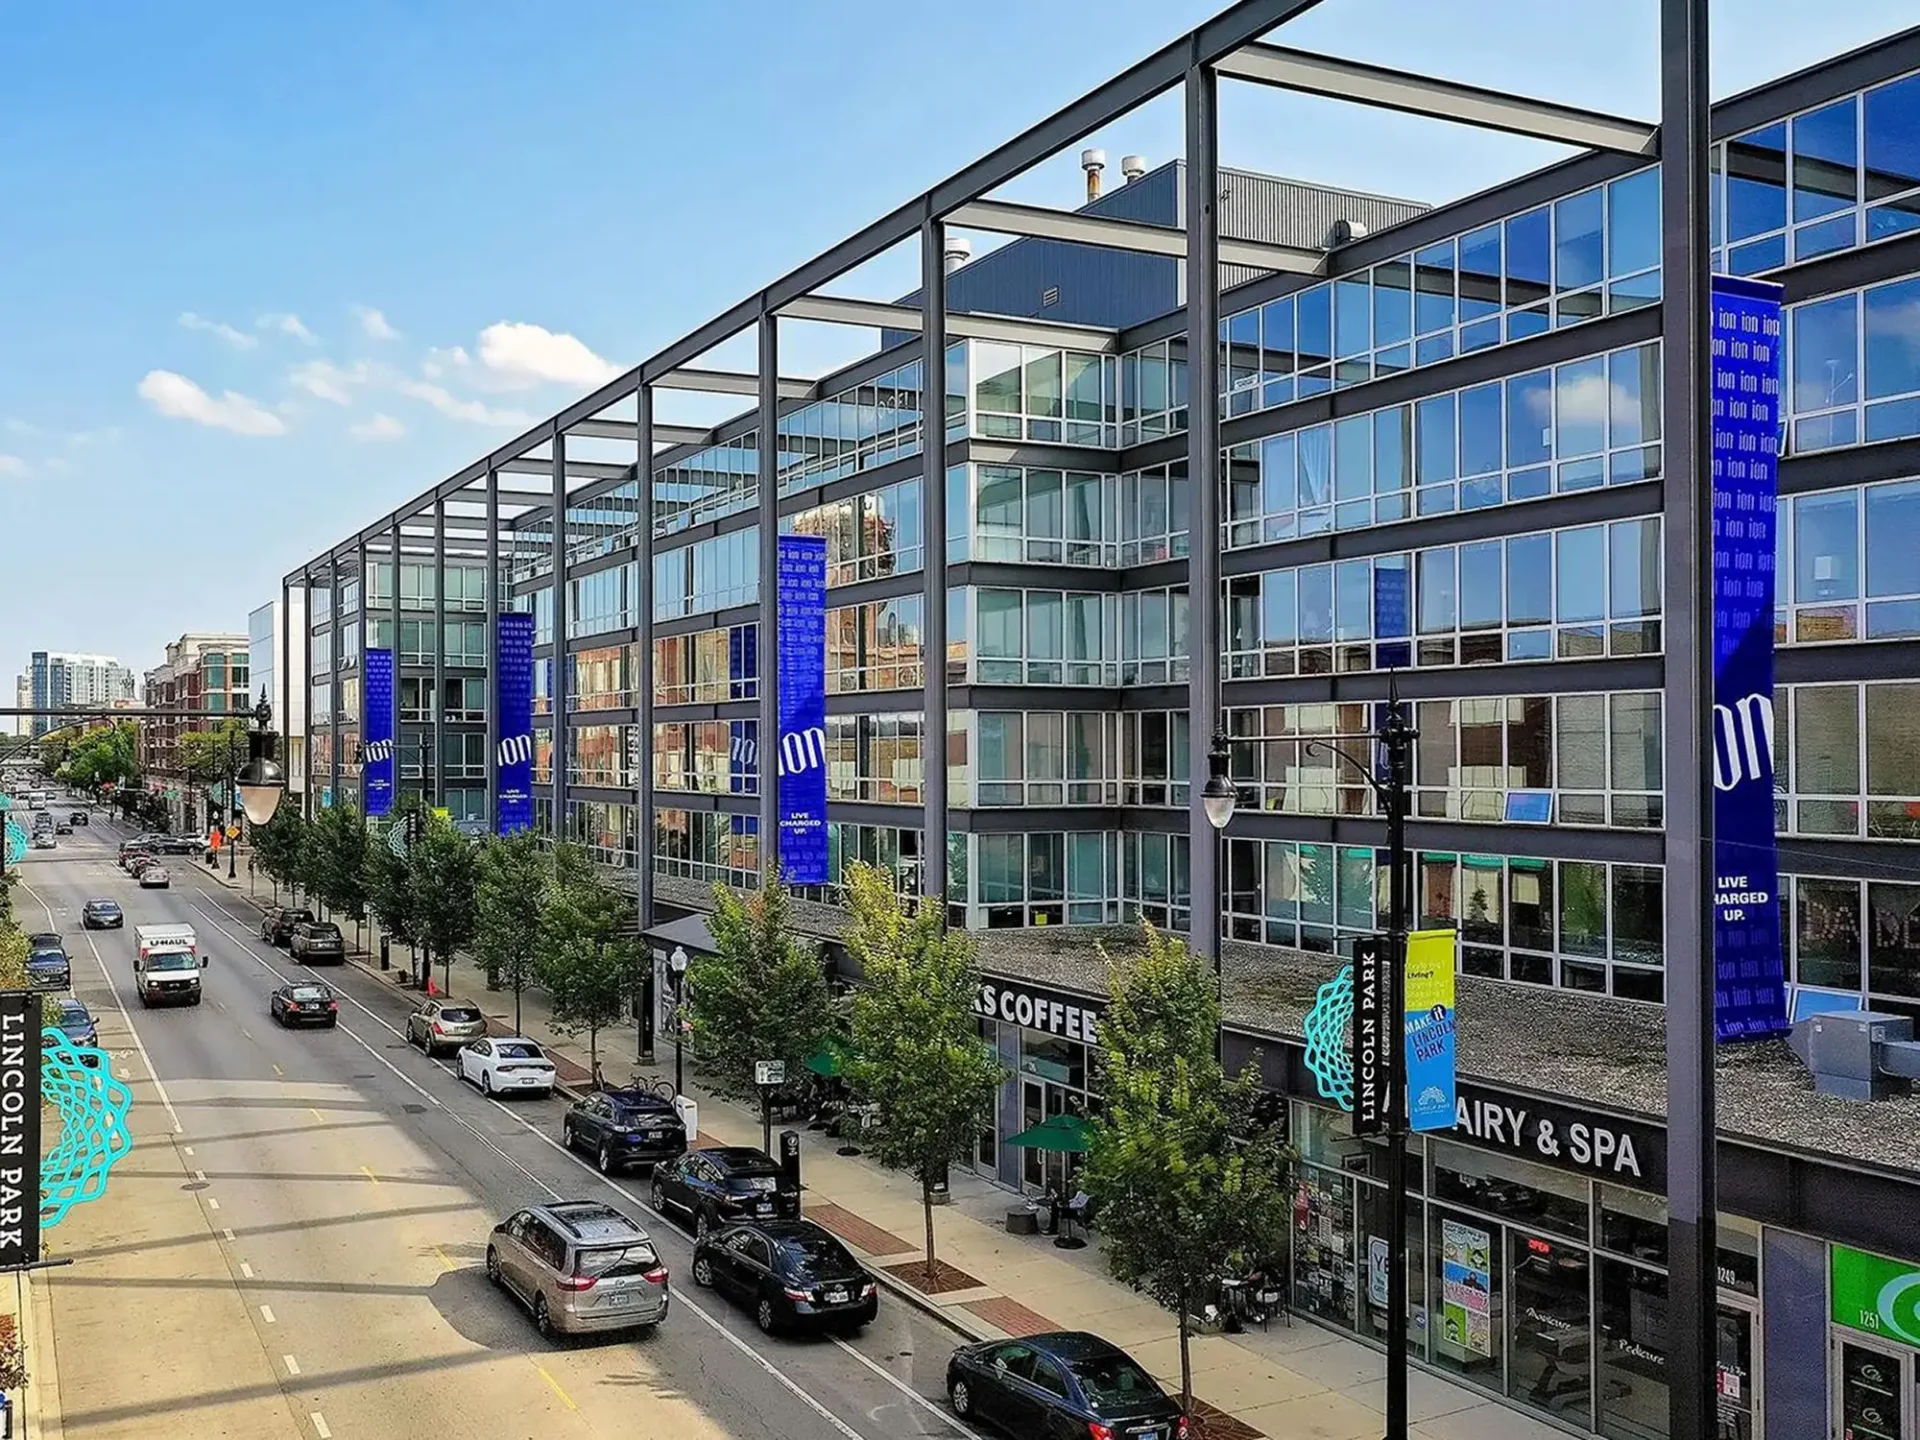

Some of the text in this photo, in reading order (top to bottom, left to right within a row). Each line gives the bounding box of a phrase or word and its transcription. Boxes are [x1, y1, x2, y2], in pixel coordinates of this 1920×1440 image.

[1719, 307, 1780, 336] ion ion ion
[1711, 337, 1769, 362] on ion ion
[1718, 367, 1778, 395] ion ion ion
[1729, 396, 1747, 419] ion
[1752, 399, 1768, 421] ion
[1716, 427, 1733, 449] ion
[1739, 430, 1756, 452] ion
[1728, 456, 1745, 479] ion
[1750, 458, 1767, 480] ion
[1737, 489, 1754, 511] ion
[1726, 516, 1743, 538] ion
[1714, 693, 1774, 791] on
[1718, 876, 1748, 888] LIVE
[1714, 891, 1768, 905] ARGED
[1724, 909, 1745, 921] UP.
[1001, 990, 1097, 1043] COFFEE
[1405, 1005, 1444, 1035] MAKE it
[1362, 952, 1375, 1121] LINCOLN PARK
[1411, 1019, 1456, 1048] LINCOLN
[1415, 1039, 1446, 1062] PARK
[0, 1013, 25, 1249] LINCOLN PARK
[1537, 1119, 1560, 1157] &
[1570, 1123, 1641, 1177] SPA
[1717, 1266, 1735, 1285] 1249
[1860, 1310, 1879, 1330] 1251
[1619, 1339, 1664, 1365] Pedicure
